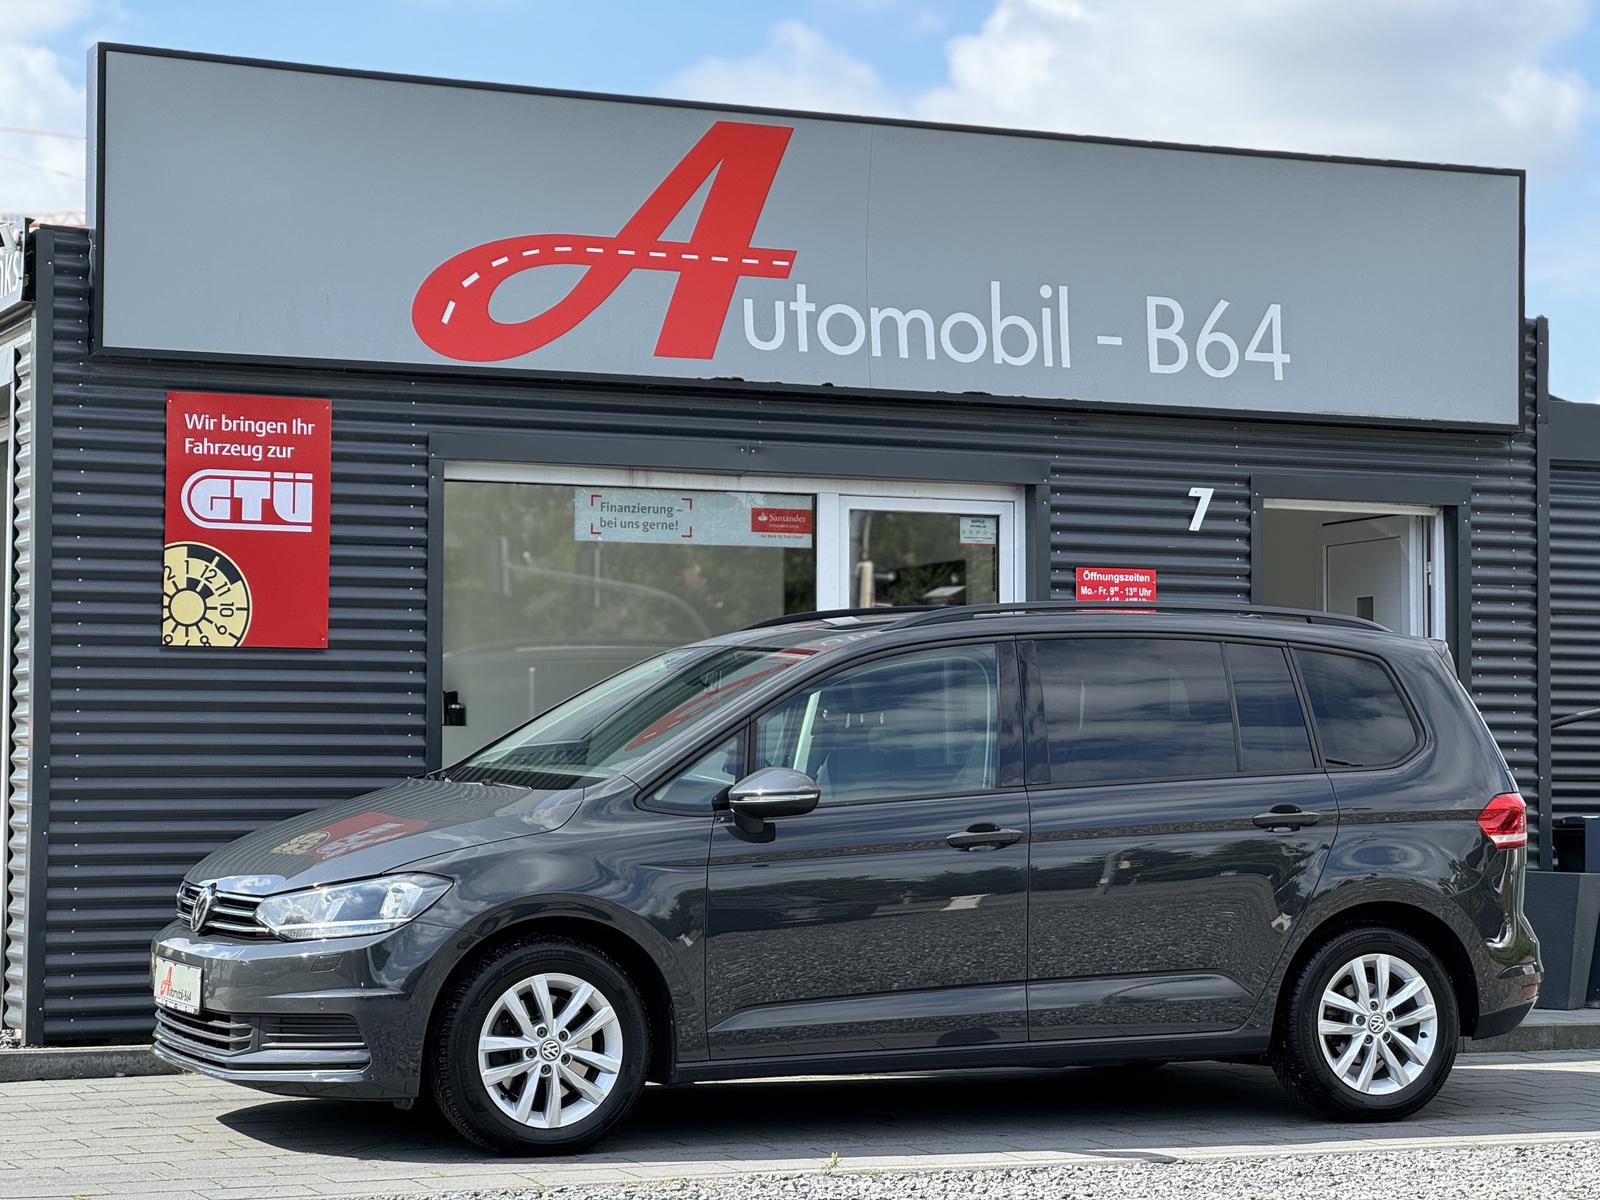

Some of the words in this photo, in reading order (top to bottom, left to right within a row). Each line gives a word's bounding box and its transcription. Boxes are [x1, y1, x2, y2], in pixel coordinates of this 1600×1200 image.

[411, 121, 1071, 369] Automobil
[1146, 295, 1291, 382] B64
[184, 413, 217, 431] Wir
[221, 414, 287, 437] bringen
[292, 418, 315, 435] Ihr
[184, 438, 262, 461] Fahrzeug
[267, 445, 294, 458] zur
[181, 469, 313, 532] GTÜ
[600, 502, 674, 518] Finanzierung
[1188, 487, 1215, 532] 7
[600, 517, 617, 528] bei
[620, 520, 640, 529] uns
[642, 520, 679, 532] gerne!
[768, 513, 806, 523] Santander
[1083, 569, 1150, 583] Öffnungszeiten
[1098, 586, 1108, 595] Fr.
[1139, 588, 1152, 597] Uhr
[219, 601, 235, 617] 10
